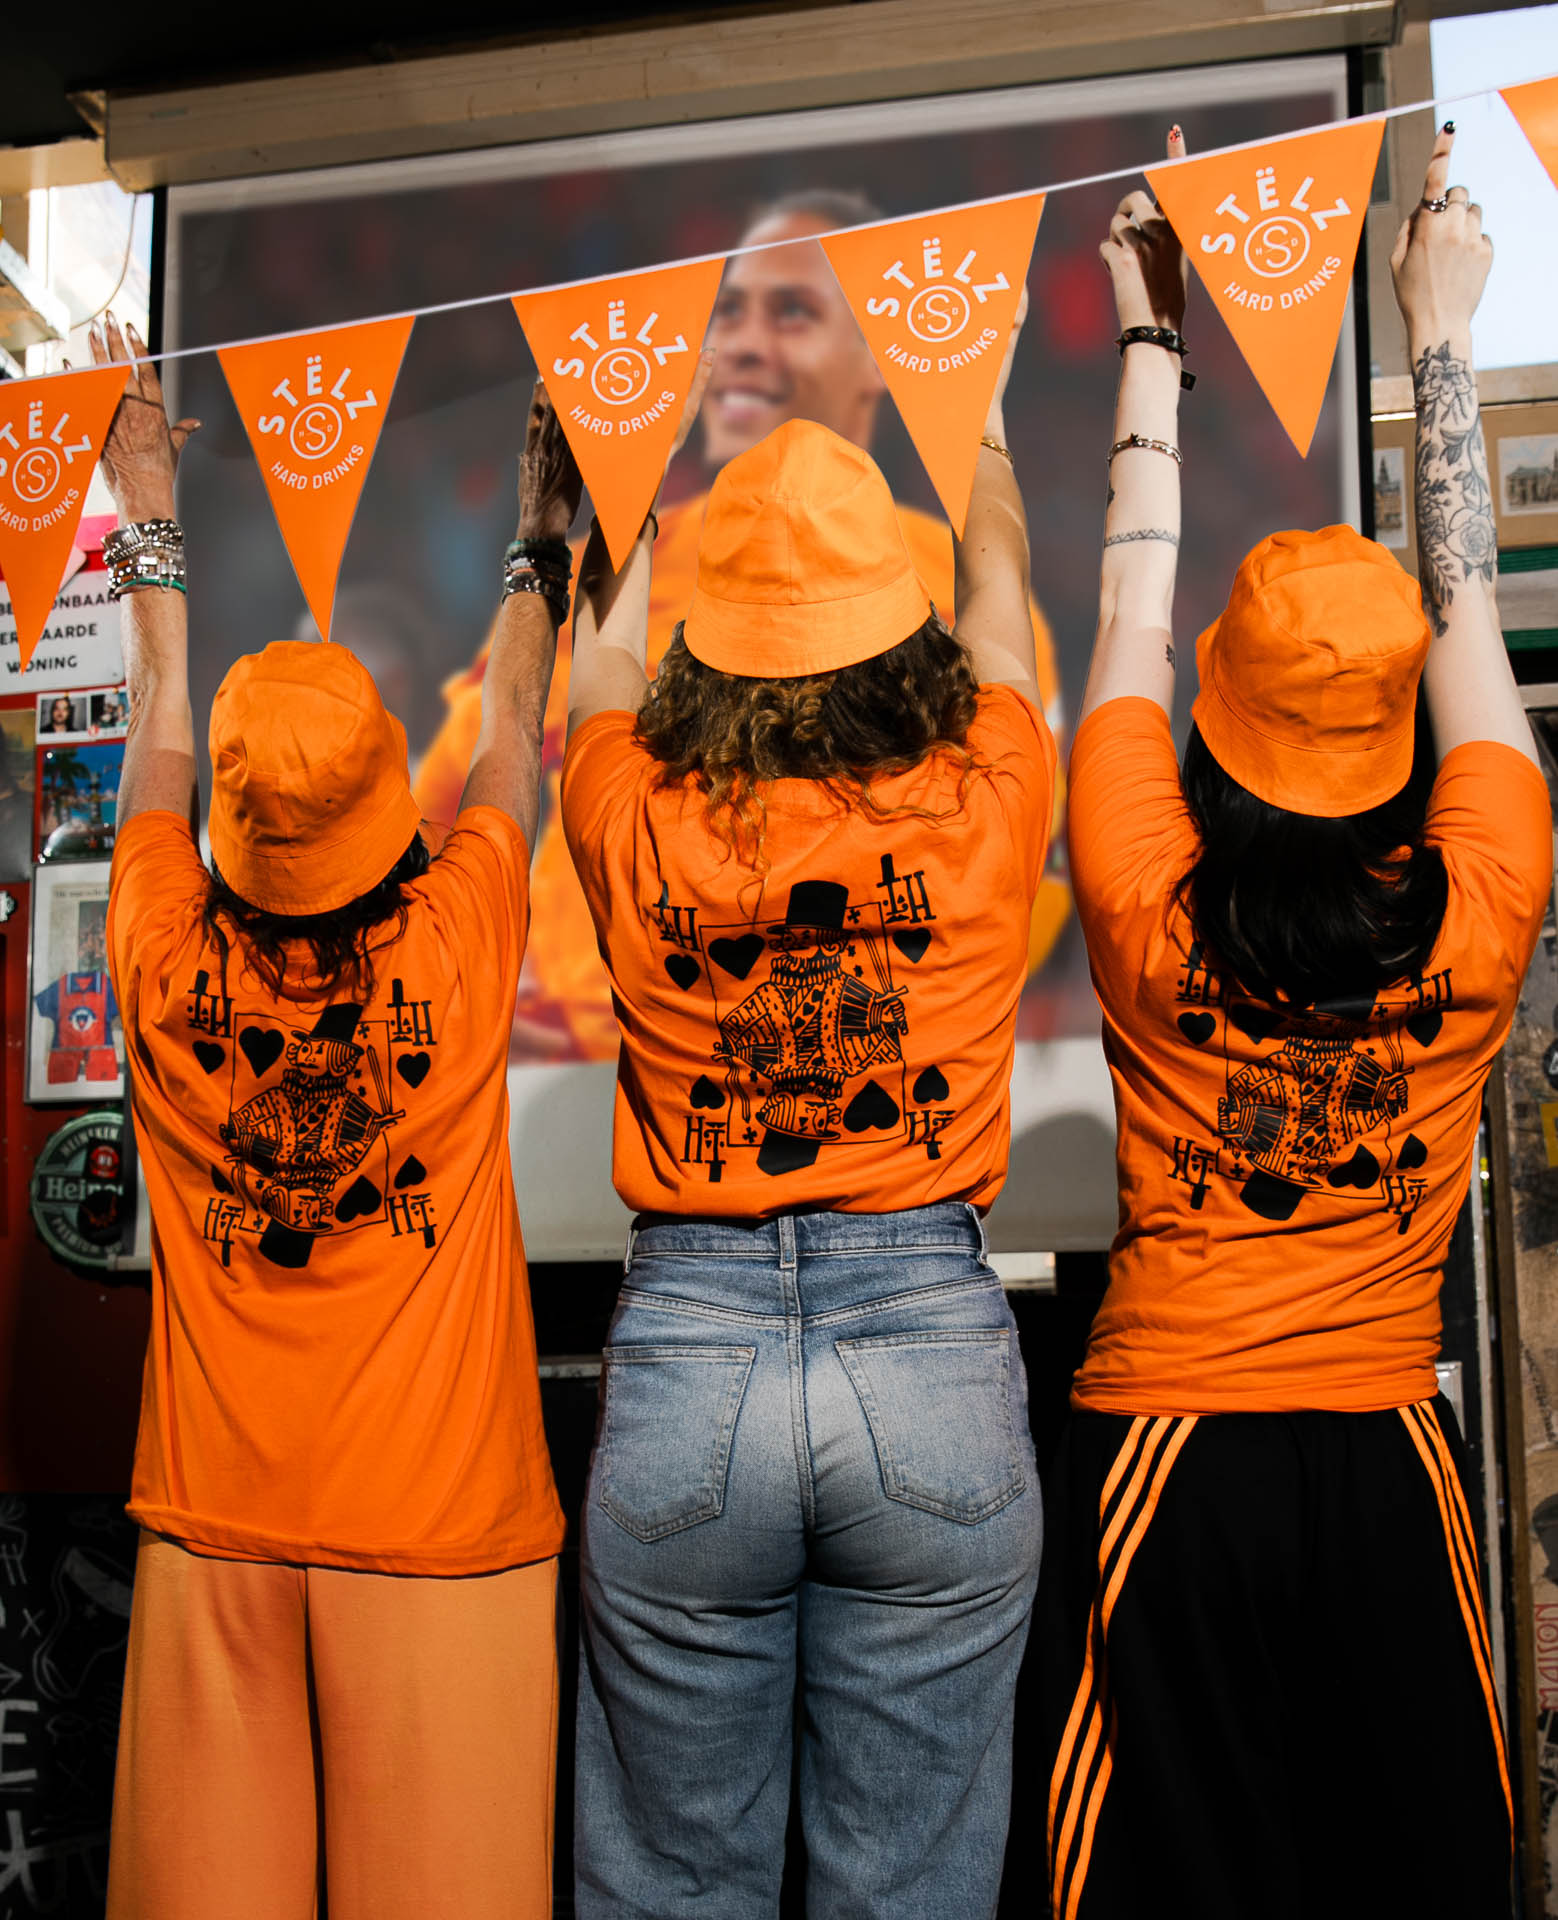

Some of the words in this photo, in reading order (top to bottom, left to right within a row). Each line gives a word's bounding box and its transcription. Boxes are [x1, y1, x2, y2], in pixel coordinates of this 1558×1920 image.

[1200, 166, 1352, 254] STËLZ
[866, 237, 1011, 317] STËLZ
[1223, 281, 1273, 311] HARD
[1280, 256, 1342, 309] DRINKS
[553, 299, 689, 379] STËLZ
[884, 343, 931, 373] HARD
[938, 327, 998, 373] DRINKS
[257, 355, 378, 435] STËLZ
[569, 405, 613, 436] HARD
[620, 390, 676, 435] DRINKS
[270, 461, 308, 490] HARD
[312, 444, 364, 489] DRINKS
[33, 488, 79, 532] DRINKS
